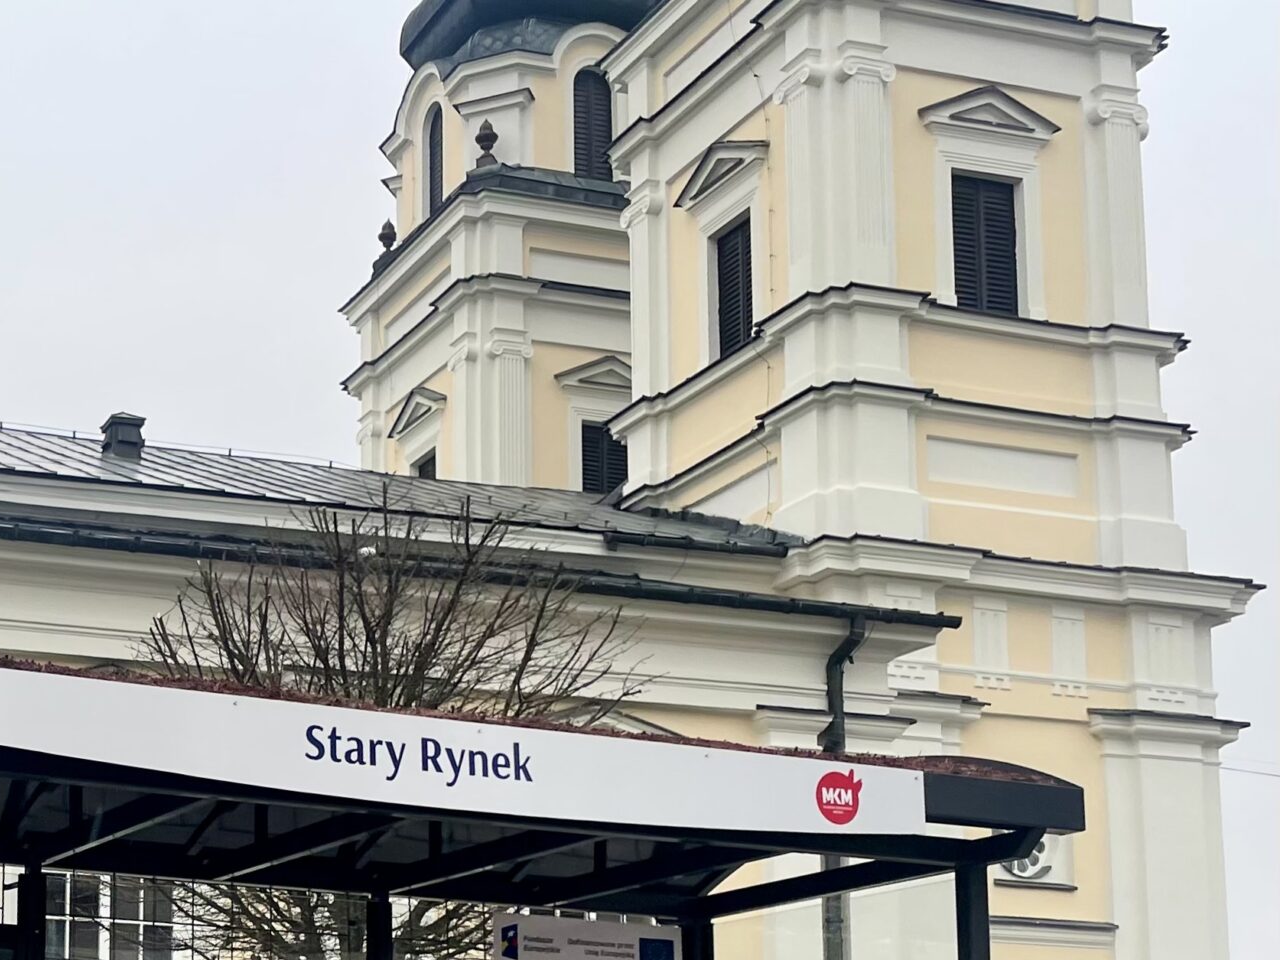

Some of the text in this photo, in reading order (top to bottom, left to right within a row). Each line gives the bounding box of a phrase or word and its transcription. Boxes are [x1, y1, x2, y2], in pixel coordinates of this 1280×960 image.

[304, 724, 534, 788] Stary Rynek
[821, 786, 854, 807] MKM
